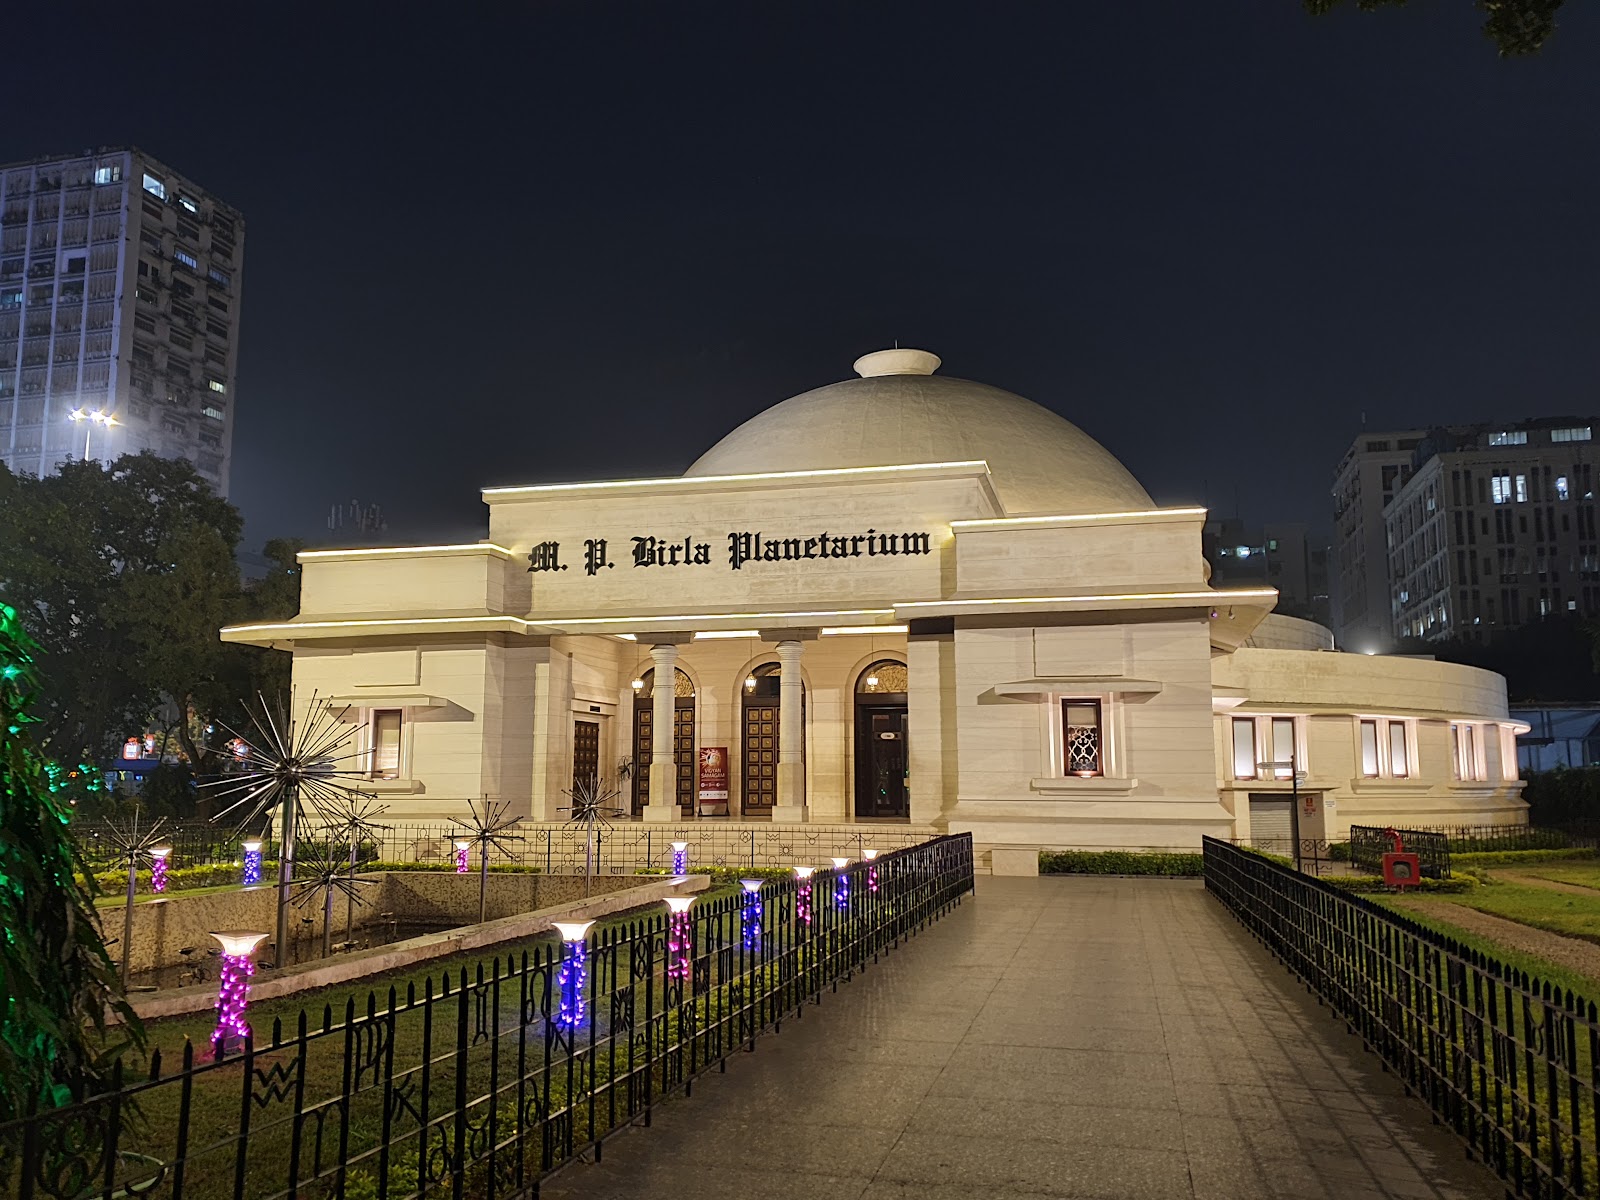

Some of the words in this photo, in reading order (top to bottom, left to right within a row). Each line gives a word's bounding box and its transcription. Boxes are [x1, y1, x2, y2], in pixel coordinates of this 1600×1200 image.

[527, 541, 568, 574] M.
[584, 538, 614, 576] P.
[630, 535, 710, 567] Birla
[728, 529, 930, 570] Planetarium
